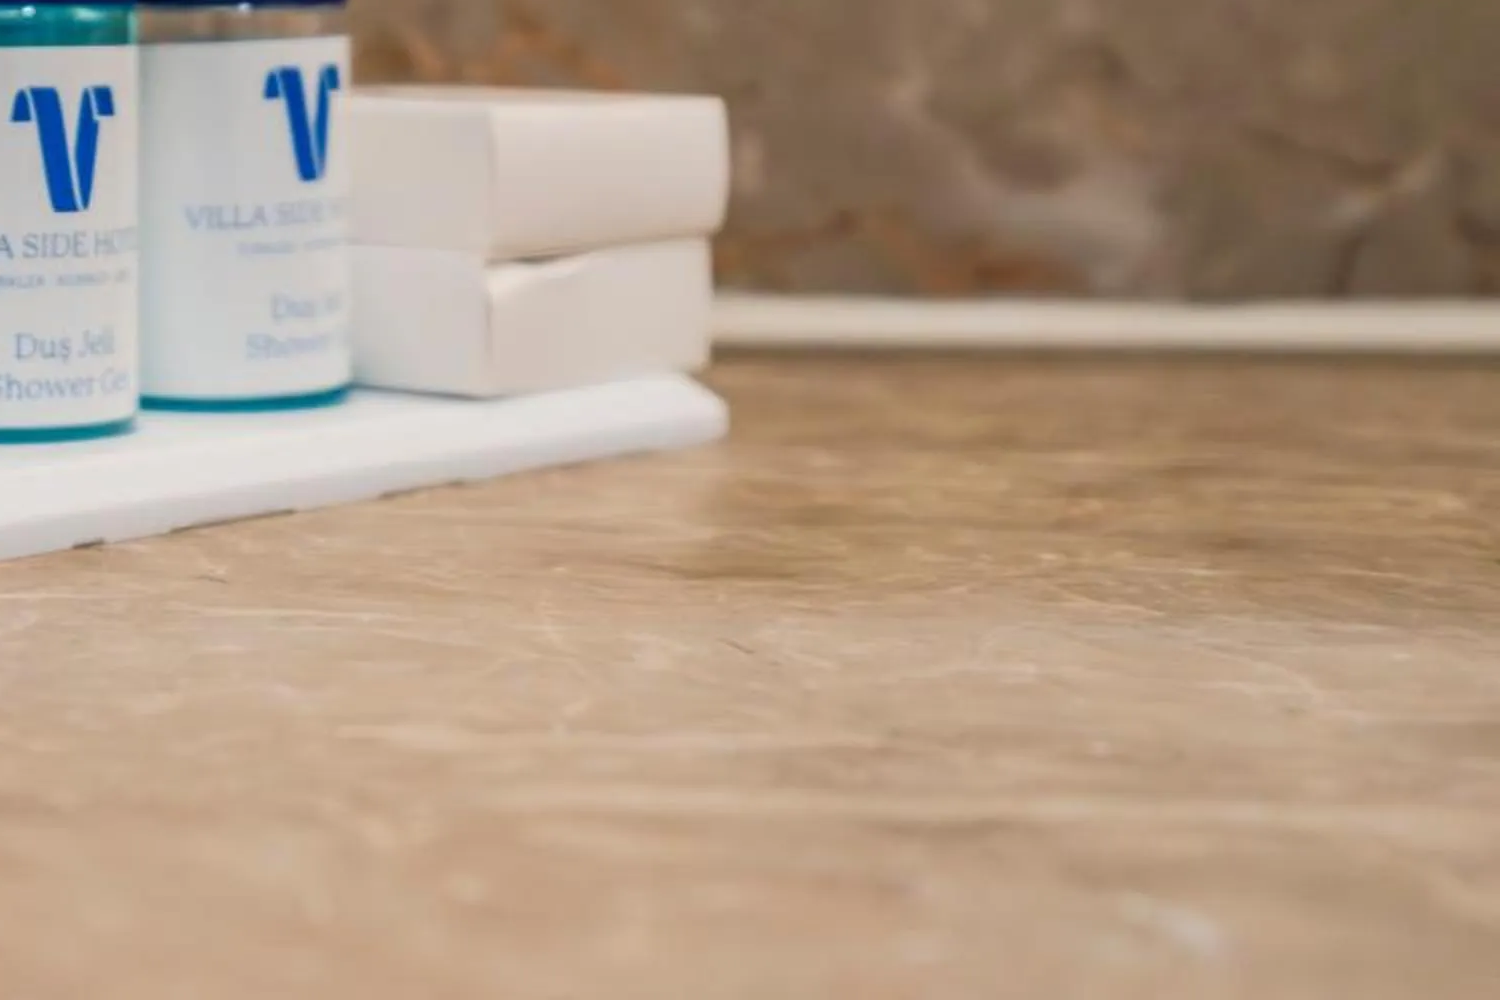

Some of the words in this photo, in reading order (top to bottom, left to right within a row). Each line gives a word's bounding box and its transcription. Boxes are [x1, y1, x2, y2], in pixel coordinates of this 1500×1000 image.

[21, 230, 90, 260] SIDE
[13, 331, 73, 366] Duş
[98, 367, 130, 396] Ge
